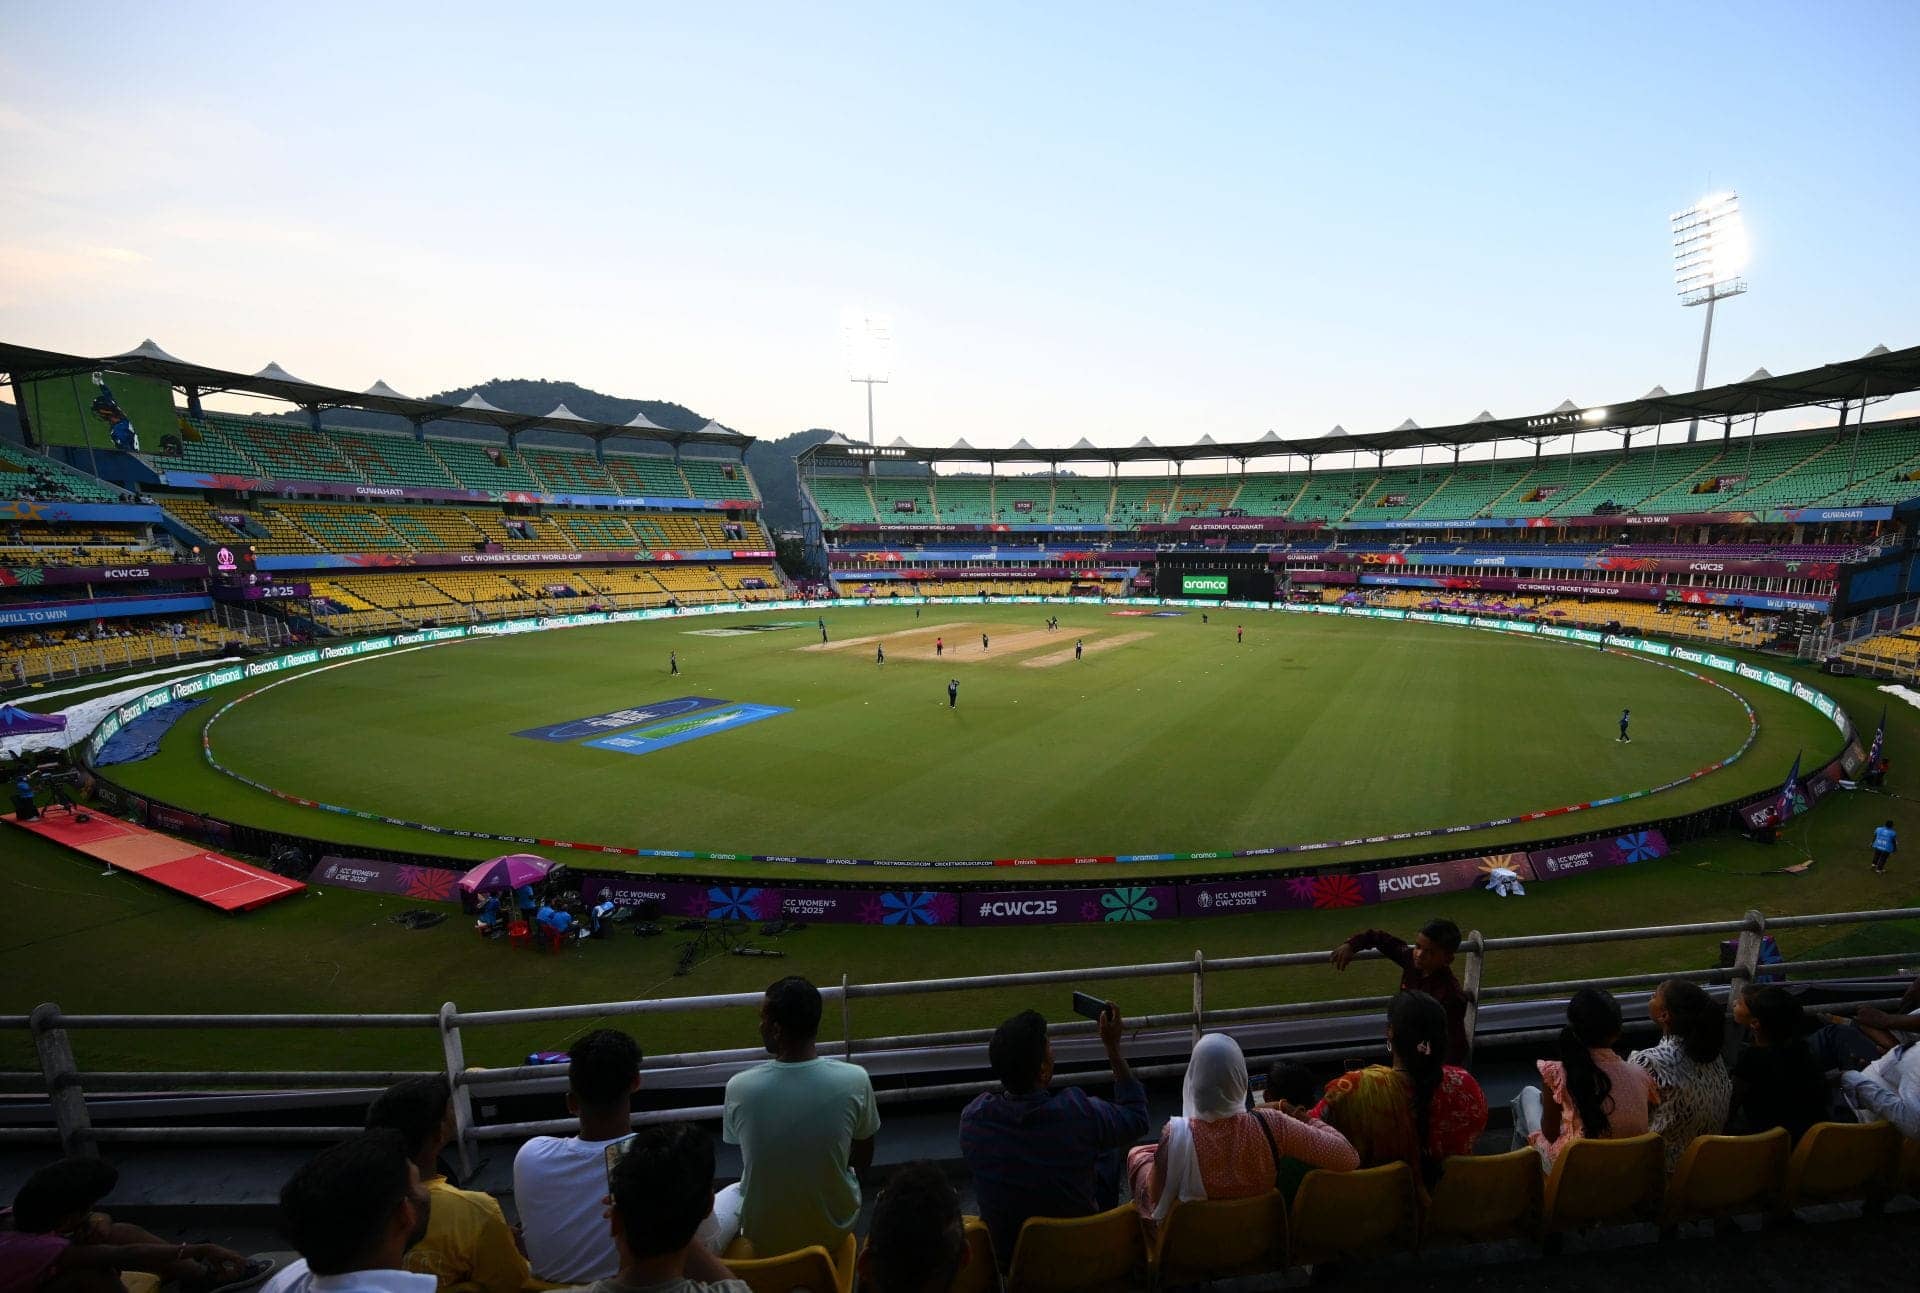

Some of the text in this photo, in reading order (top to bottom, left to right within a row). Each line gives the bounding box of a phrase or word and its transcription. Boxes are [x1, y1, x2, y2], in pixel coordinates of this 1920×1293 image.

[356, 487, 404, 496] GUWAHATI
[1822, 511, 1863, 519] GUWAHATI
[568, 519, 672, 547] ACA
[1690, 563, 1724, 571] #CWC25
[104, 569, 150, 578] #CWC25
[1184, 580, 1226, 589] aramco
[1556, 585, 1581, 593] CRICKET
[1787, 600, 1797, 608] TO
[0, 610, 67, 623] WILL TO WIN
[398, 632, 425, 645] Rexona
[433, 629, 463, 640] Rexona
[361, 639, 389, 651] Rexona
[1609, 634, 1635, 648] Rexona
[325, 645, 353, 658] Rexona
[1675, 647, 1703, 662] Rexona
[287, 652, 316, 666] Rexona
[250, 660, 279, 675] Rexona
[211, 669, 240, 685] Rexona
[176, 680, 203, 698] Rexona
[1557, 851, 1594, 864] ICC WOMEN'S
[1560, 862, 1574, 870] CWC
[1378, 873, 1441, 893] #CWC25
[615, 890, 666, 900] ICC WOMEN'S
[1215, 890, 1267, 900] ICC WOMEN'S
[798, 899, 837, 907] WOMEN'S
[1215, 899, 1234, 907] CWC
[801, 906, 824, 914] 2025
[979, 900, 1058, 918] #CWC25
